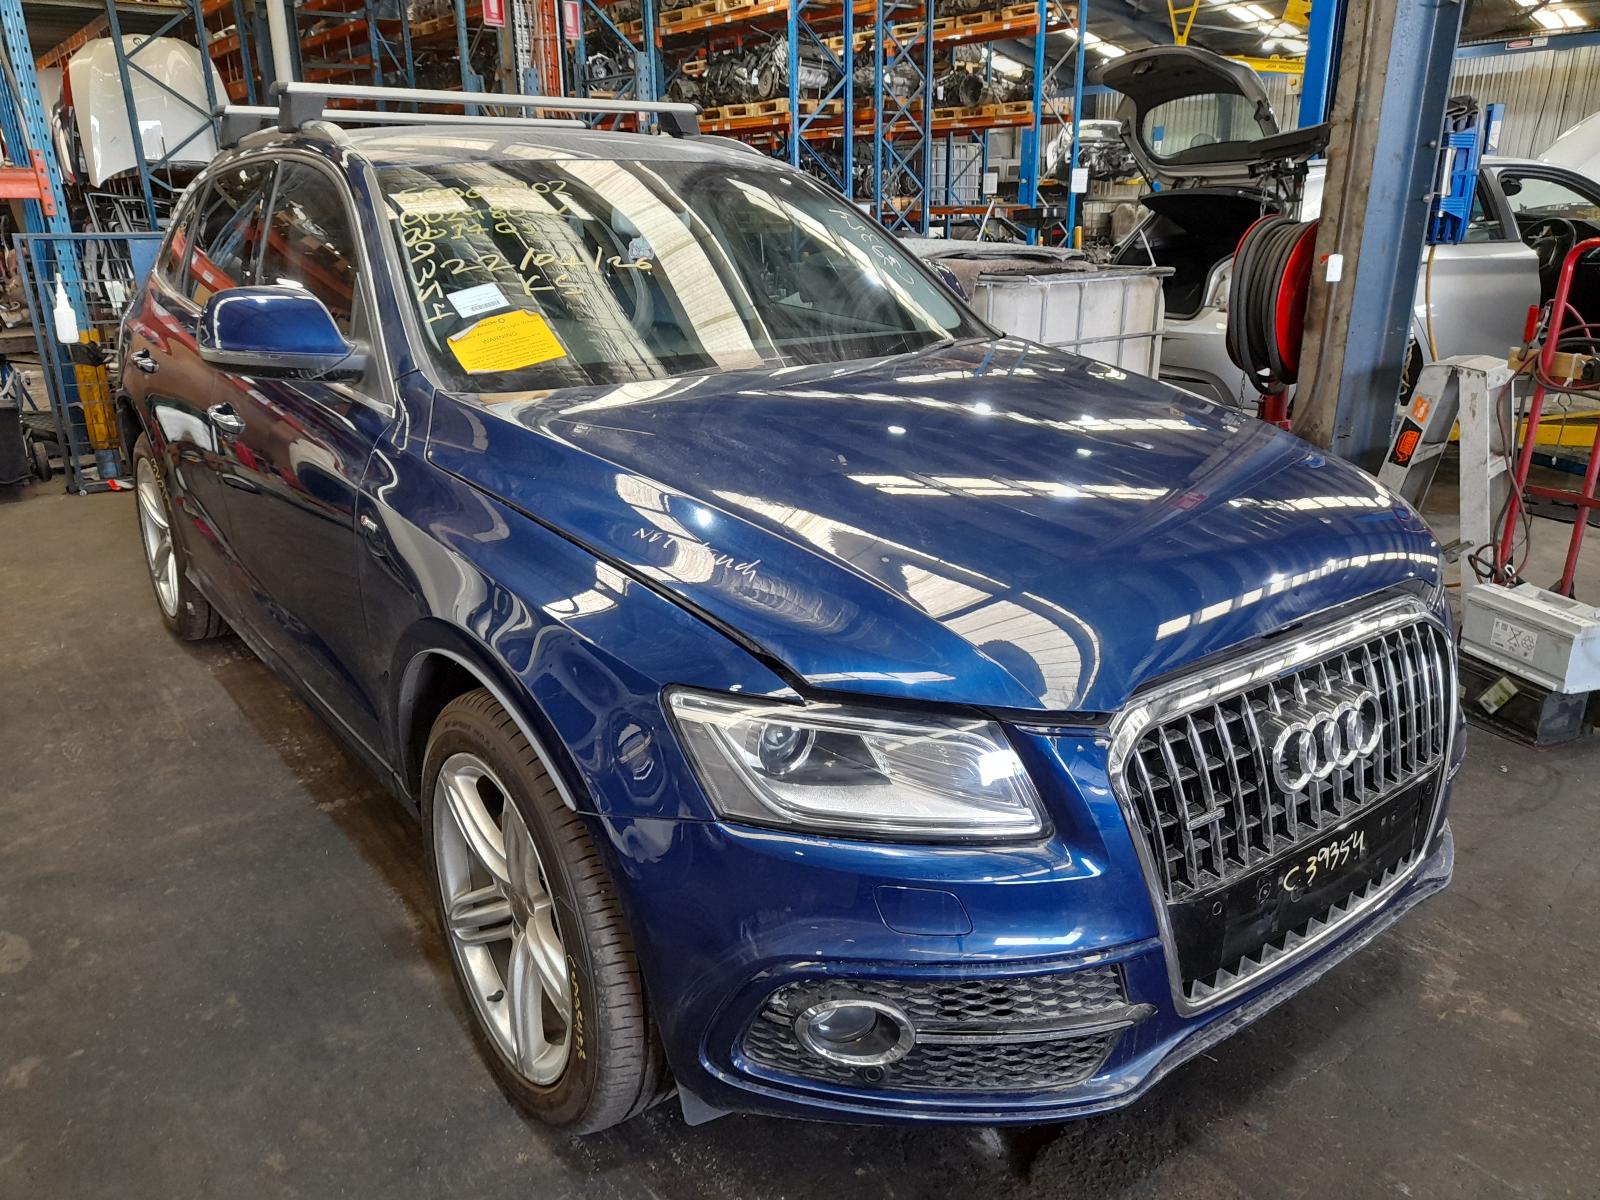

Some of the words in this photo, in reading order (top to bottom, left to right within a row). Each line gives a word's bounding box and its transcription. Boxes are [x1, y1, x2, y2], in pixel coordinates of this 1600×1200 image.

[517, 273, 585, 296] KS
[482, 331, 519, 345] WARNING
[1305, 831, 1365, 885] 39354
